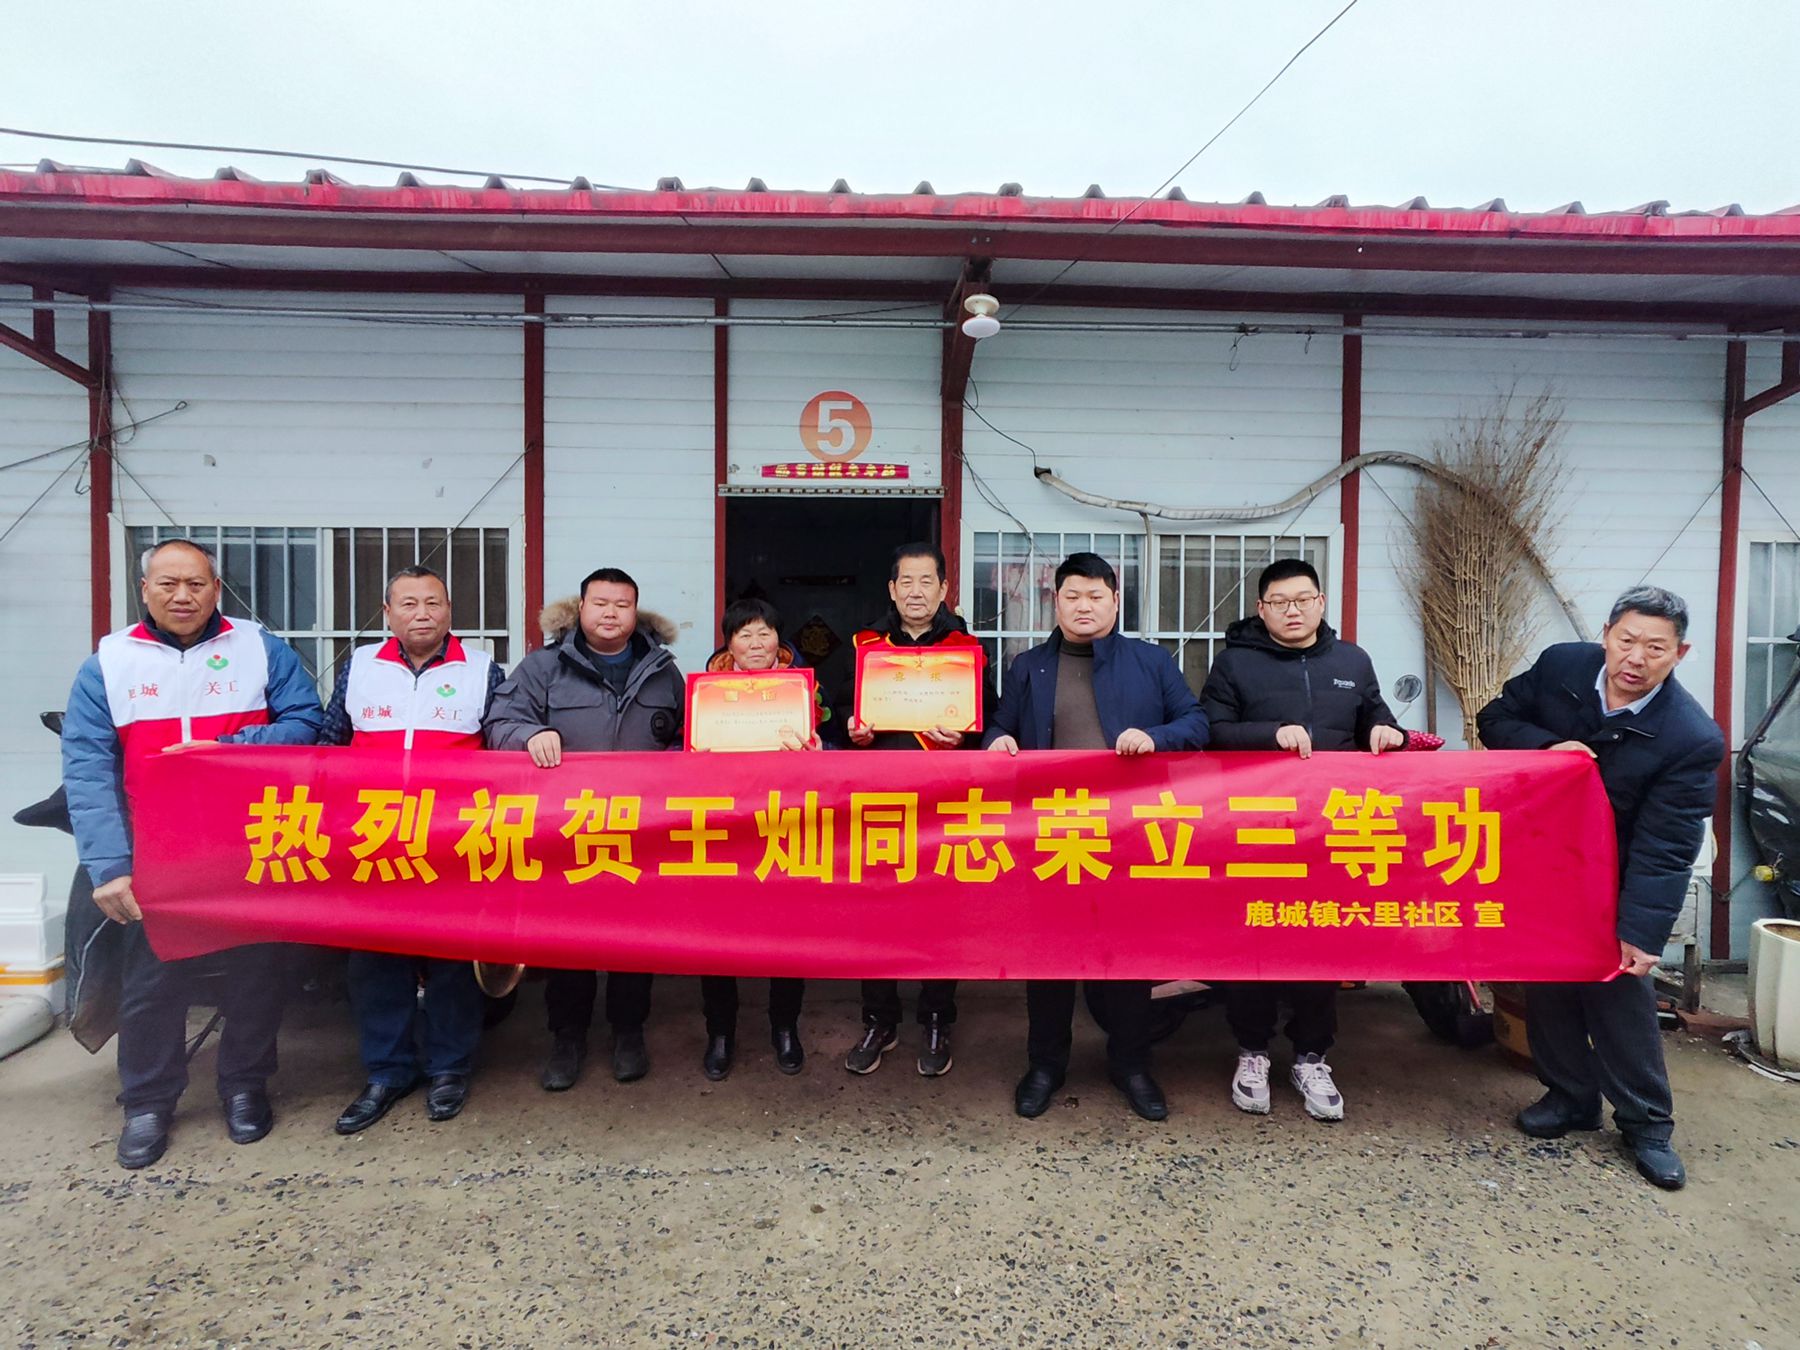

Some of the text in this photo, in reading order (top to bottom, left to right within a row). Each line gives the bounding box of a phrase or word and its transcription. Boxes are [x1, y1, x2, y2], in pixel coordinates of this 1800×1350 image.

[816, 400, 856, 456] 5
[245, 785, 1502, 886] 热烈祝贺王灿同志荣立三等功
[1246, 900, 1505, 928] 鹿城镇六里社区 宣
